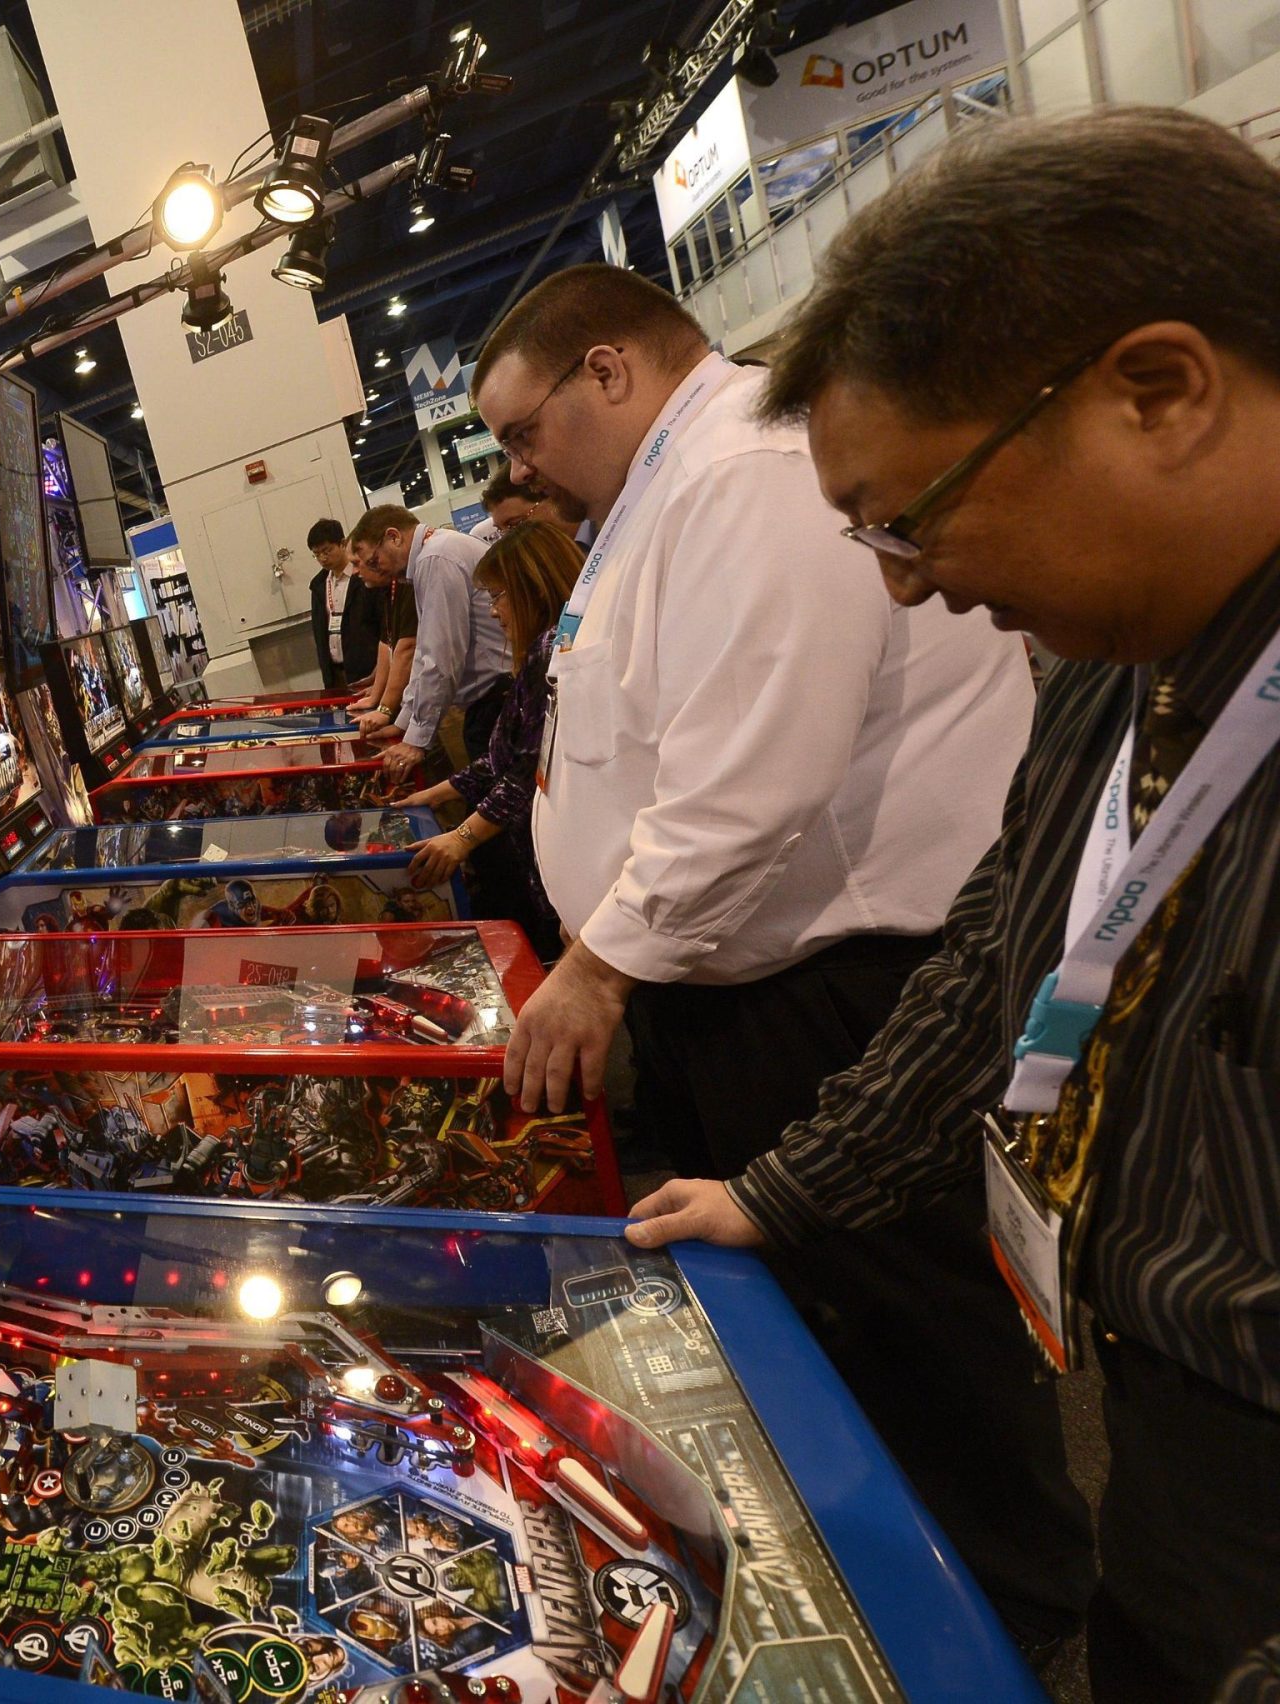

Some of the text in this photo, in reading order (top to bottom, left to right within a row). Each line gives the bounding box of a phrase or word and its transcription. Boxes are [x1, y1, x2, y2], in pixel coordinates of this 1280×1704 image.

[852, 22, 968, 84] OPTUM
[855, 85, 887, 103] Good
[890, 78, 906, 91] for
[909, 69, 928, 84] the
[688, 142, 720, 187] OPTUM
[191, 1418, 218, 1437] HOLD
[234, 1413, 268, 1435] BONUS
[433, 1487, 470, 1507] AVENGER
[471, 1504, 514, 1527] COMPLETE
[499, 1511, 511, 1520] TO
[521, 1499, 607, 1679] AVENGERS
[227, 1669, 238, 1681] 2
[263, 1648, 284, 1687] LOCK
[281, 1660, 291, 1668] 1
[158, 1668, 175, 1701] OCK
[172, 1679, 183, 1690] 3
